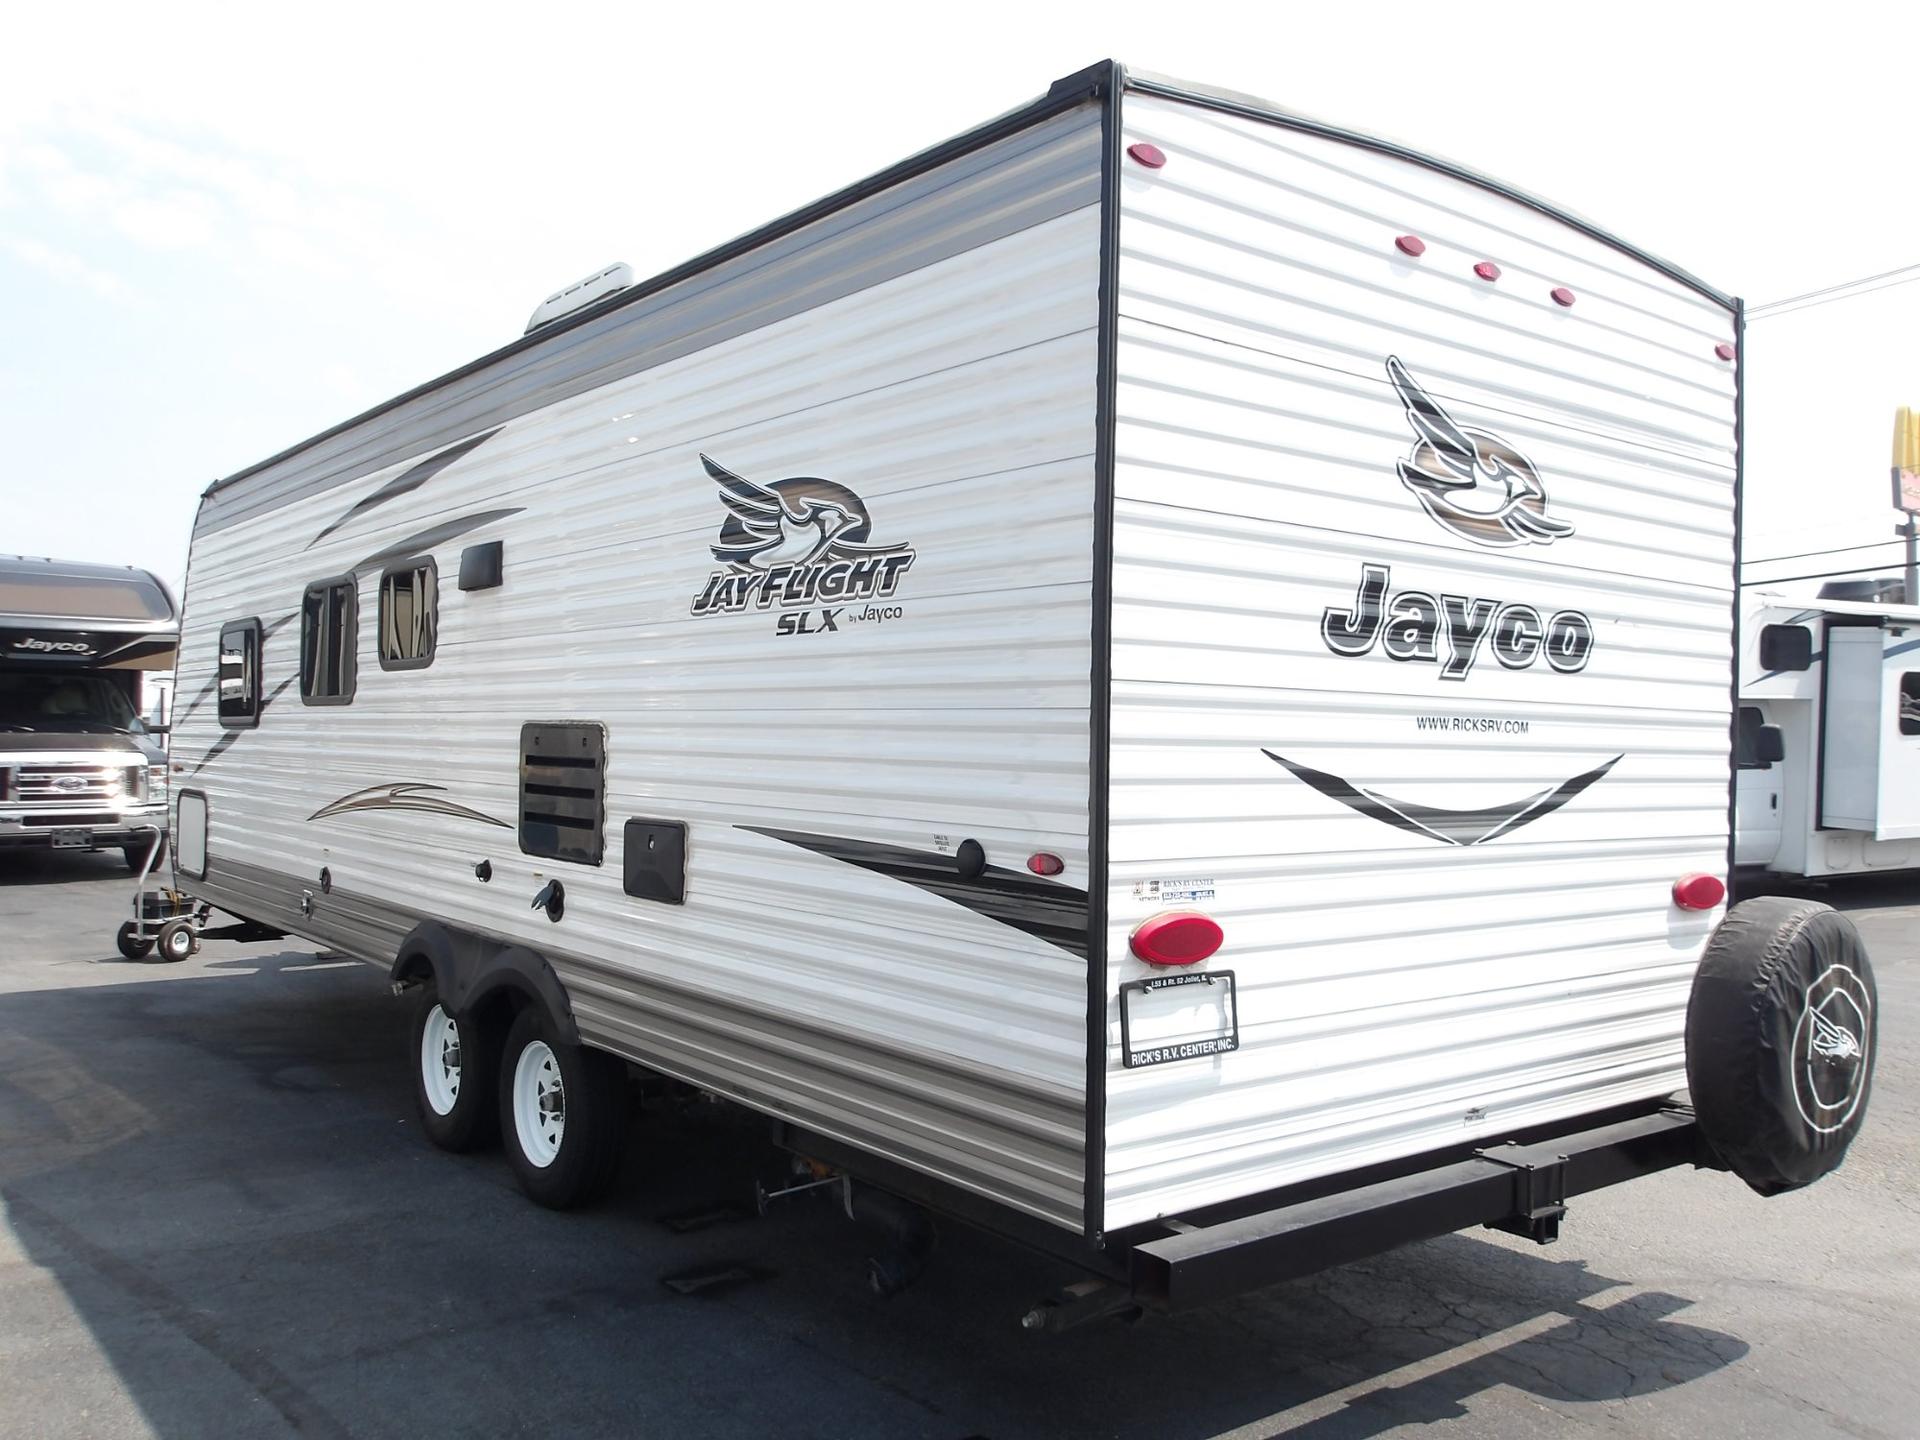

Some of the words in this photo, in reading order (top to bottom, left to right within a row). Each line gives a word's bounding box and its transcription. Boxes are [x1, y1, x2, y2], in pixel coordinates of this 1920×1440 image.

[776, 608, 845, 636] SLX
[849, 614, 858, 624] by
[857, 604, 903, 624] Jayco
[1320, 562, 1595, 682] Jayco
[13, 638, 90, 653] Jayco
[1416, 716, 1530, 734] WWW.RICKSRV.COM
[1131, 1051, 1161, 1066] RICK'S
[1162, 1047, 1179, 1060] R.V.
[1217, 1038, 1235, 1051] INC.
